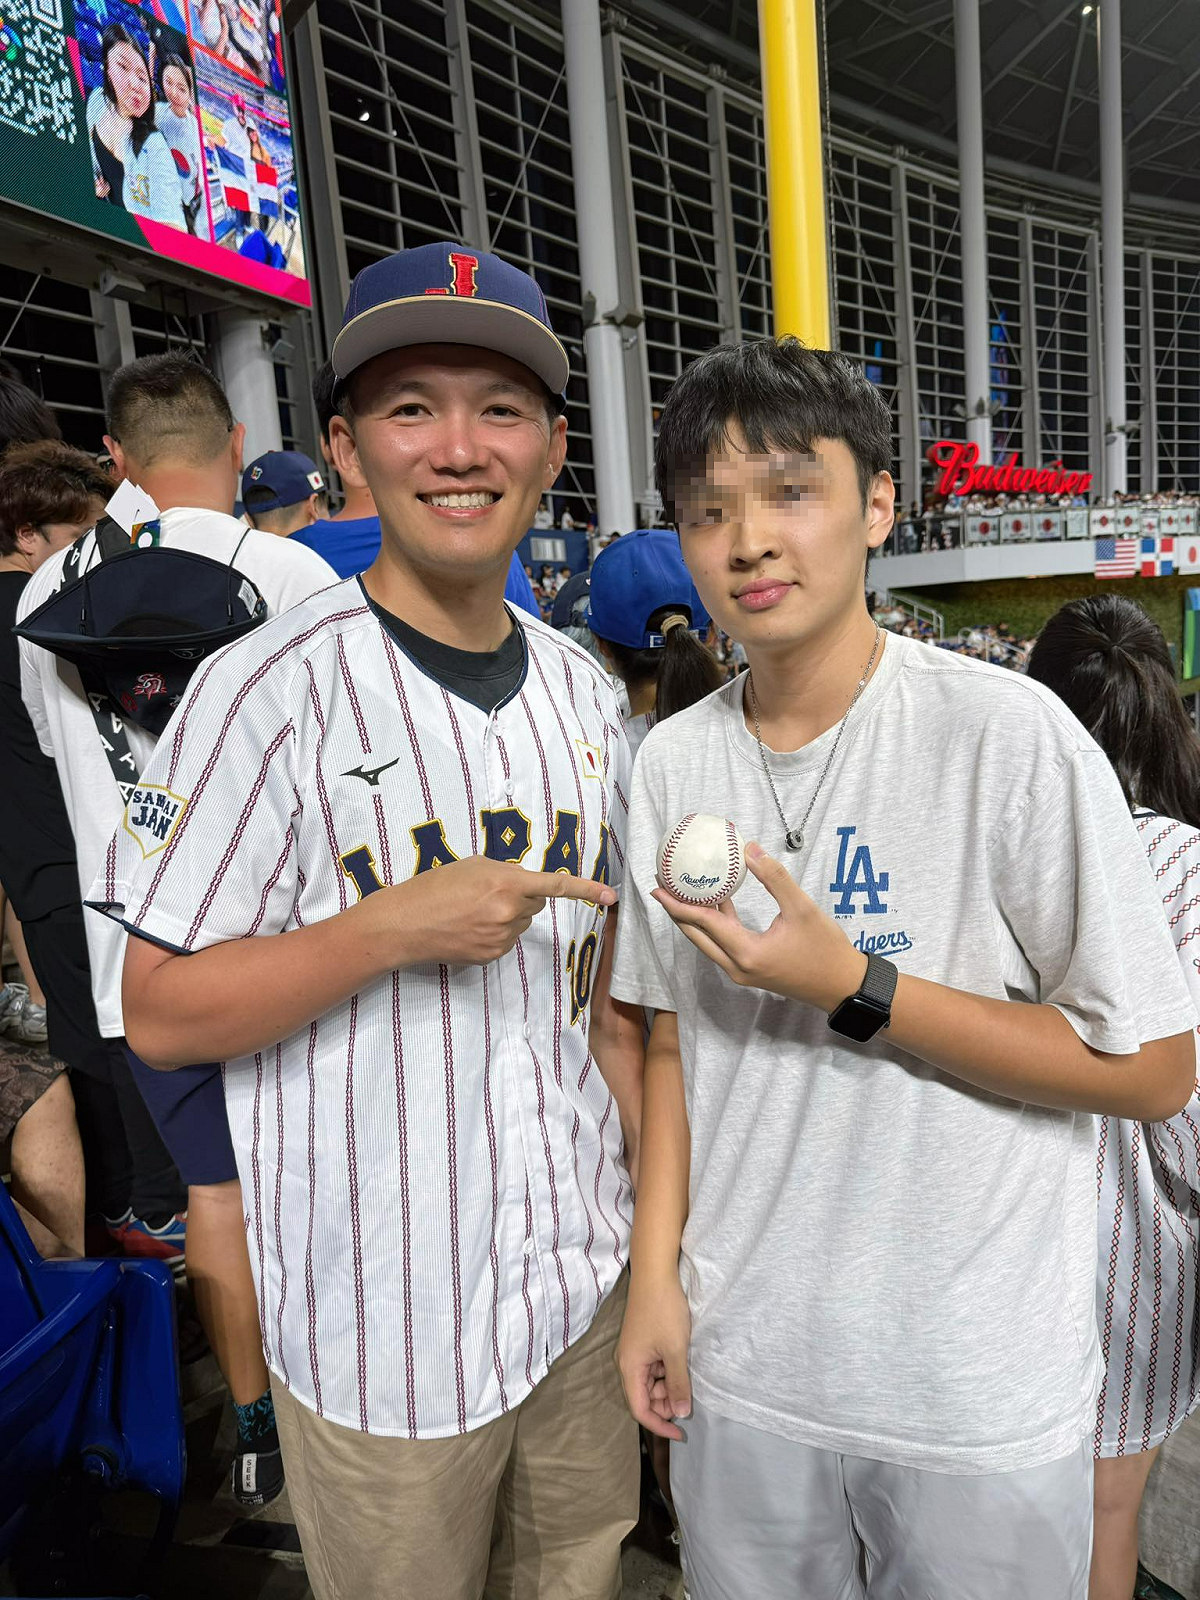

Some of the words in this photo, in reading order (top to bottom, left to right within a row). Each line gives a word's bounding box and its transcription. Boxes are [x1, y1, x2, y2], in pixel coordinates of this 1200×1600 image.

[928, 441, 1093, 495] Budweiser
[679, 872, 721, 888] Rawlings
[830, 826, 889, 914] LA
[853, 930, 913, 957] dgers
